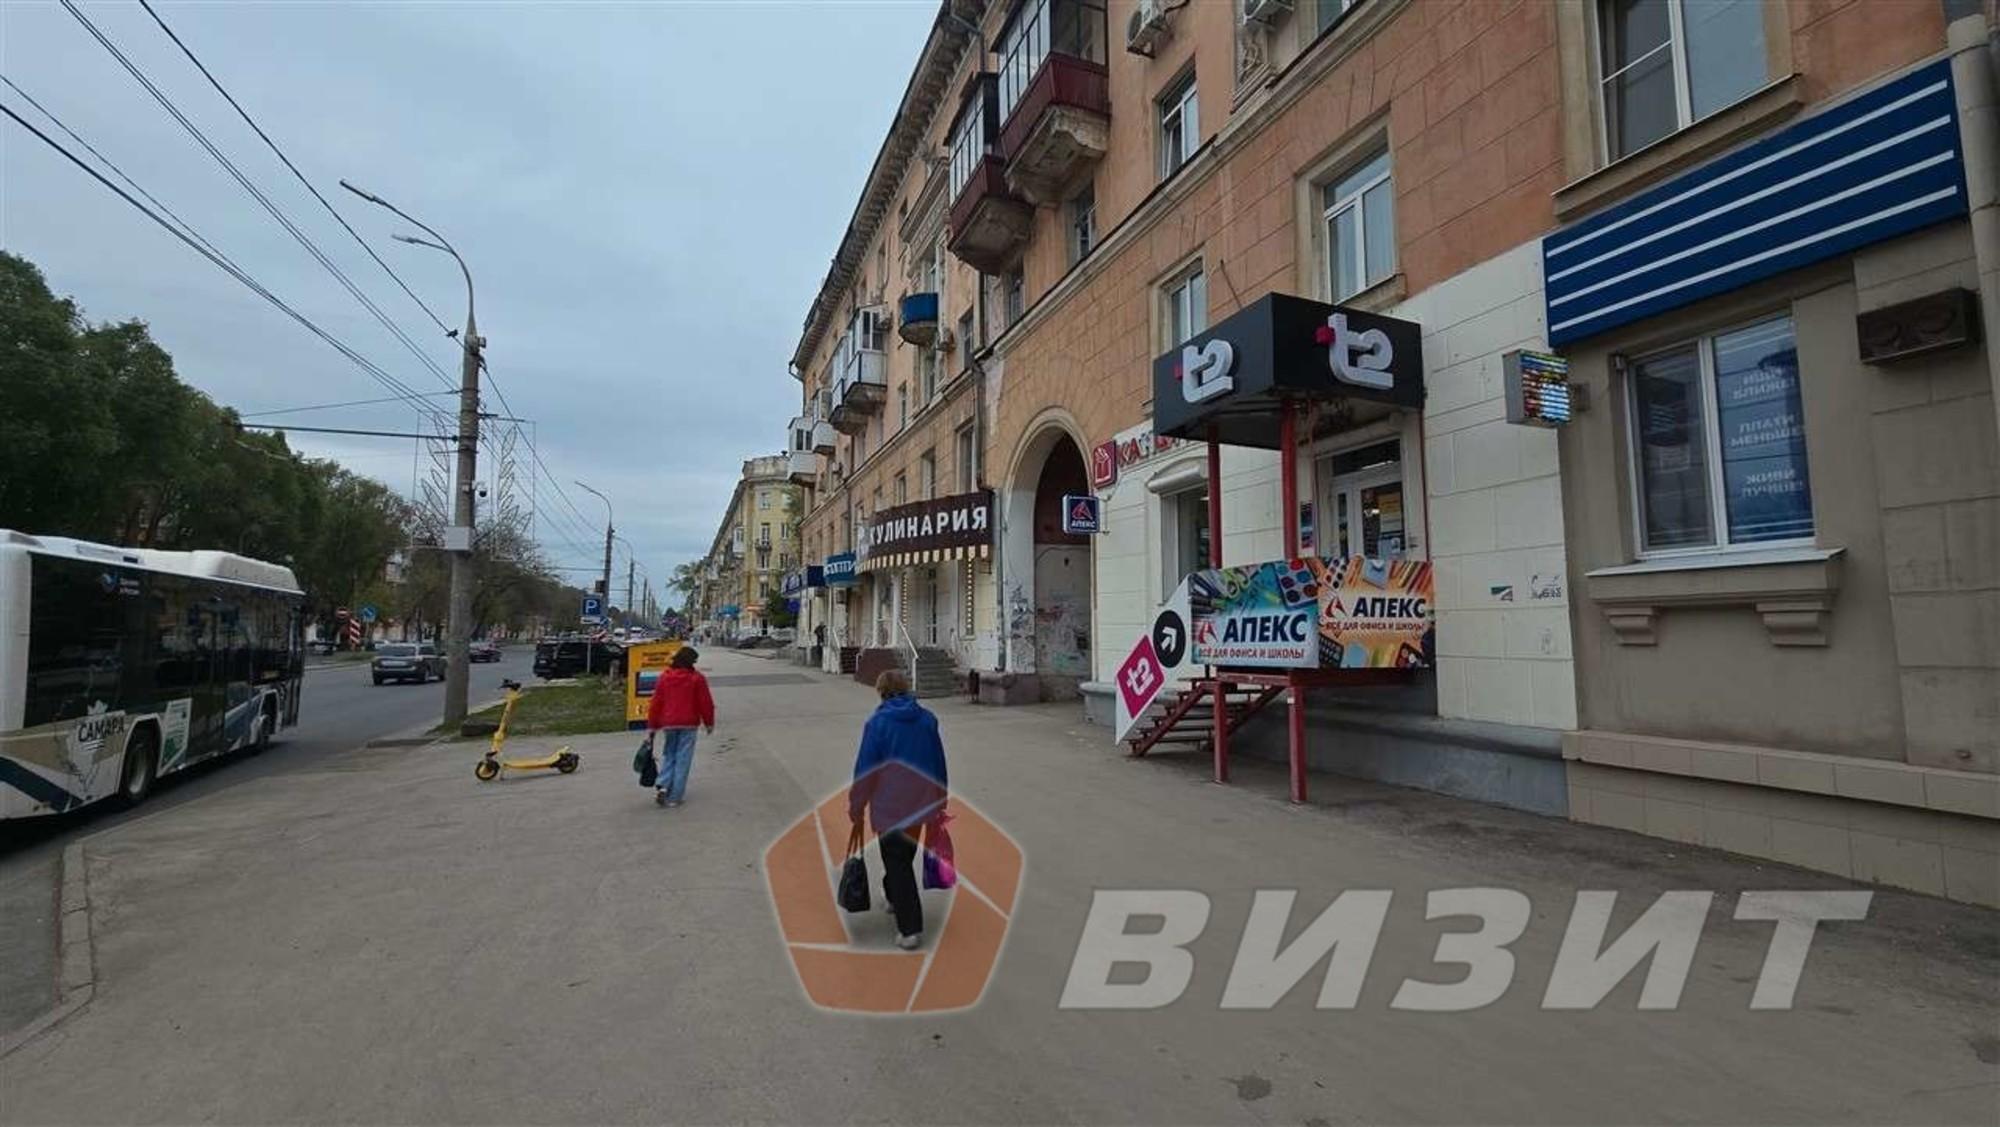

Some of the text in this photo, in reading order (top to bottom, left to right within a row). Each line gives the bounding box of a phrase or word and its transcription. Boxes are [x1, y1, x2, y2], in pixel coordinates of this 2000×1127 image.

[585, 599, 598, 614] P
[1351, 596, 1426, 619] АПЕКС
[1223, 613, 1307, 643] АПЕКС
